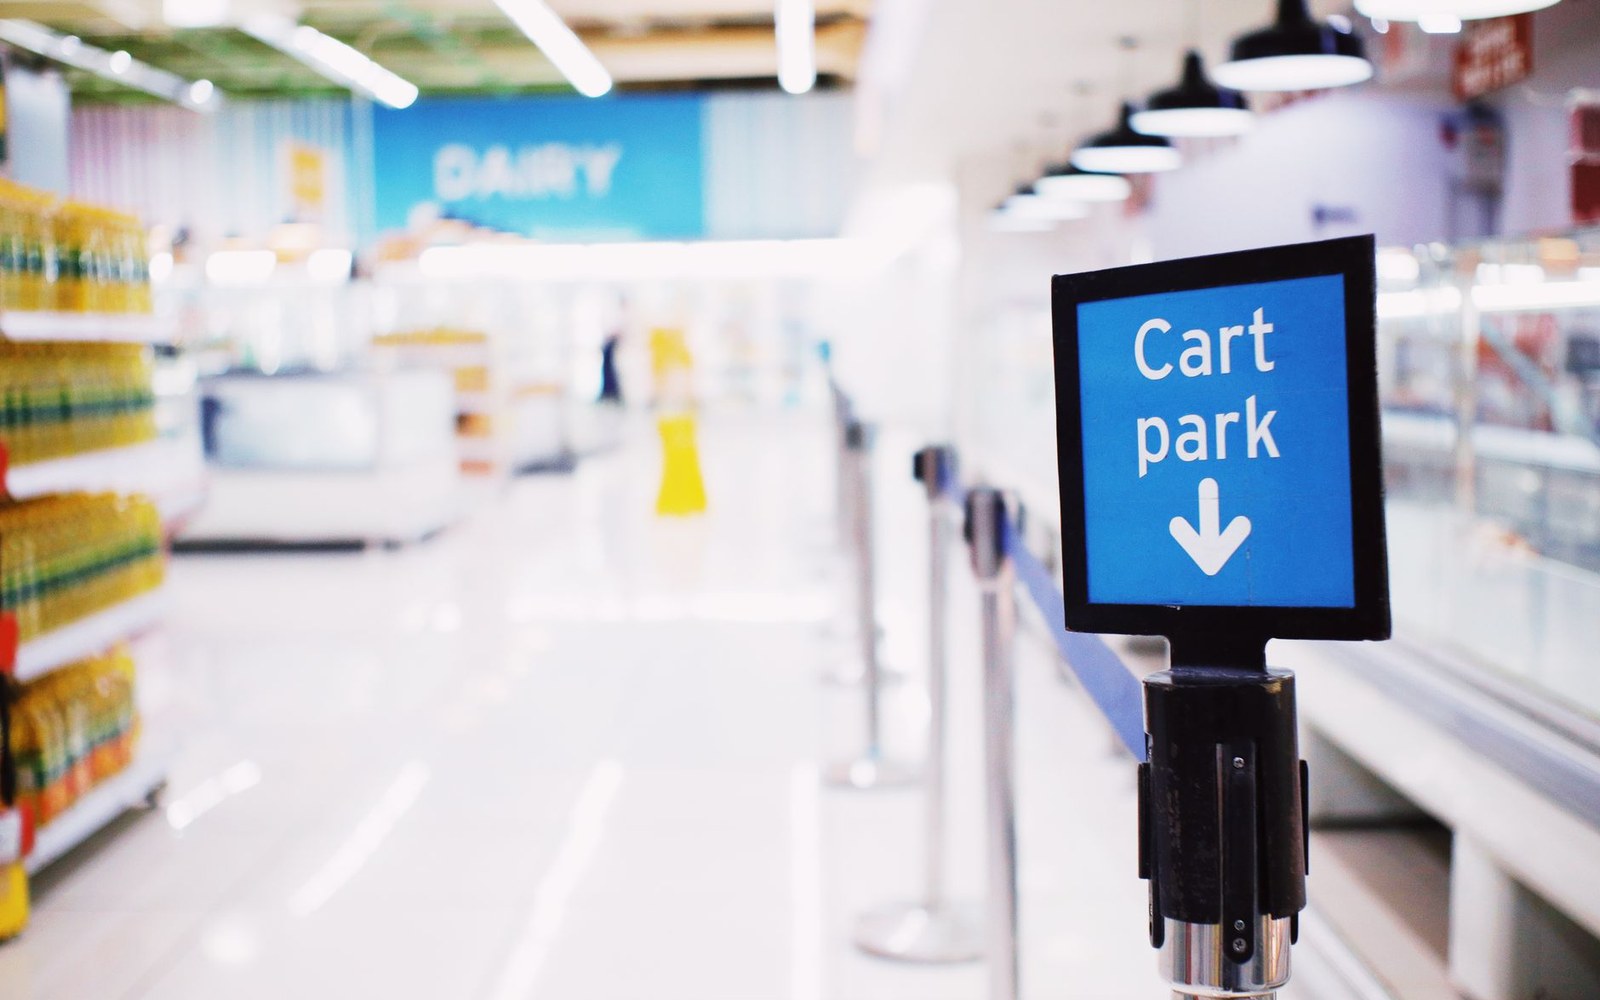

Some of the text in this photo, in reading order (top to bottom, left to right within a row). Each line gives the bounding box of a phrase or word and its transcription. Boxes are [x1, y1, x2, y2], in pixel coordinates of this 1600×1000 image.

[433, 143, 622, 200] DAIRY
[1134, 306, 1275, 381] Cart
[1136, 394, 1281, 479] park
